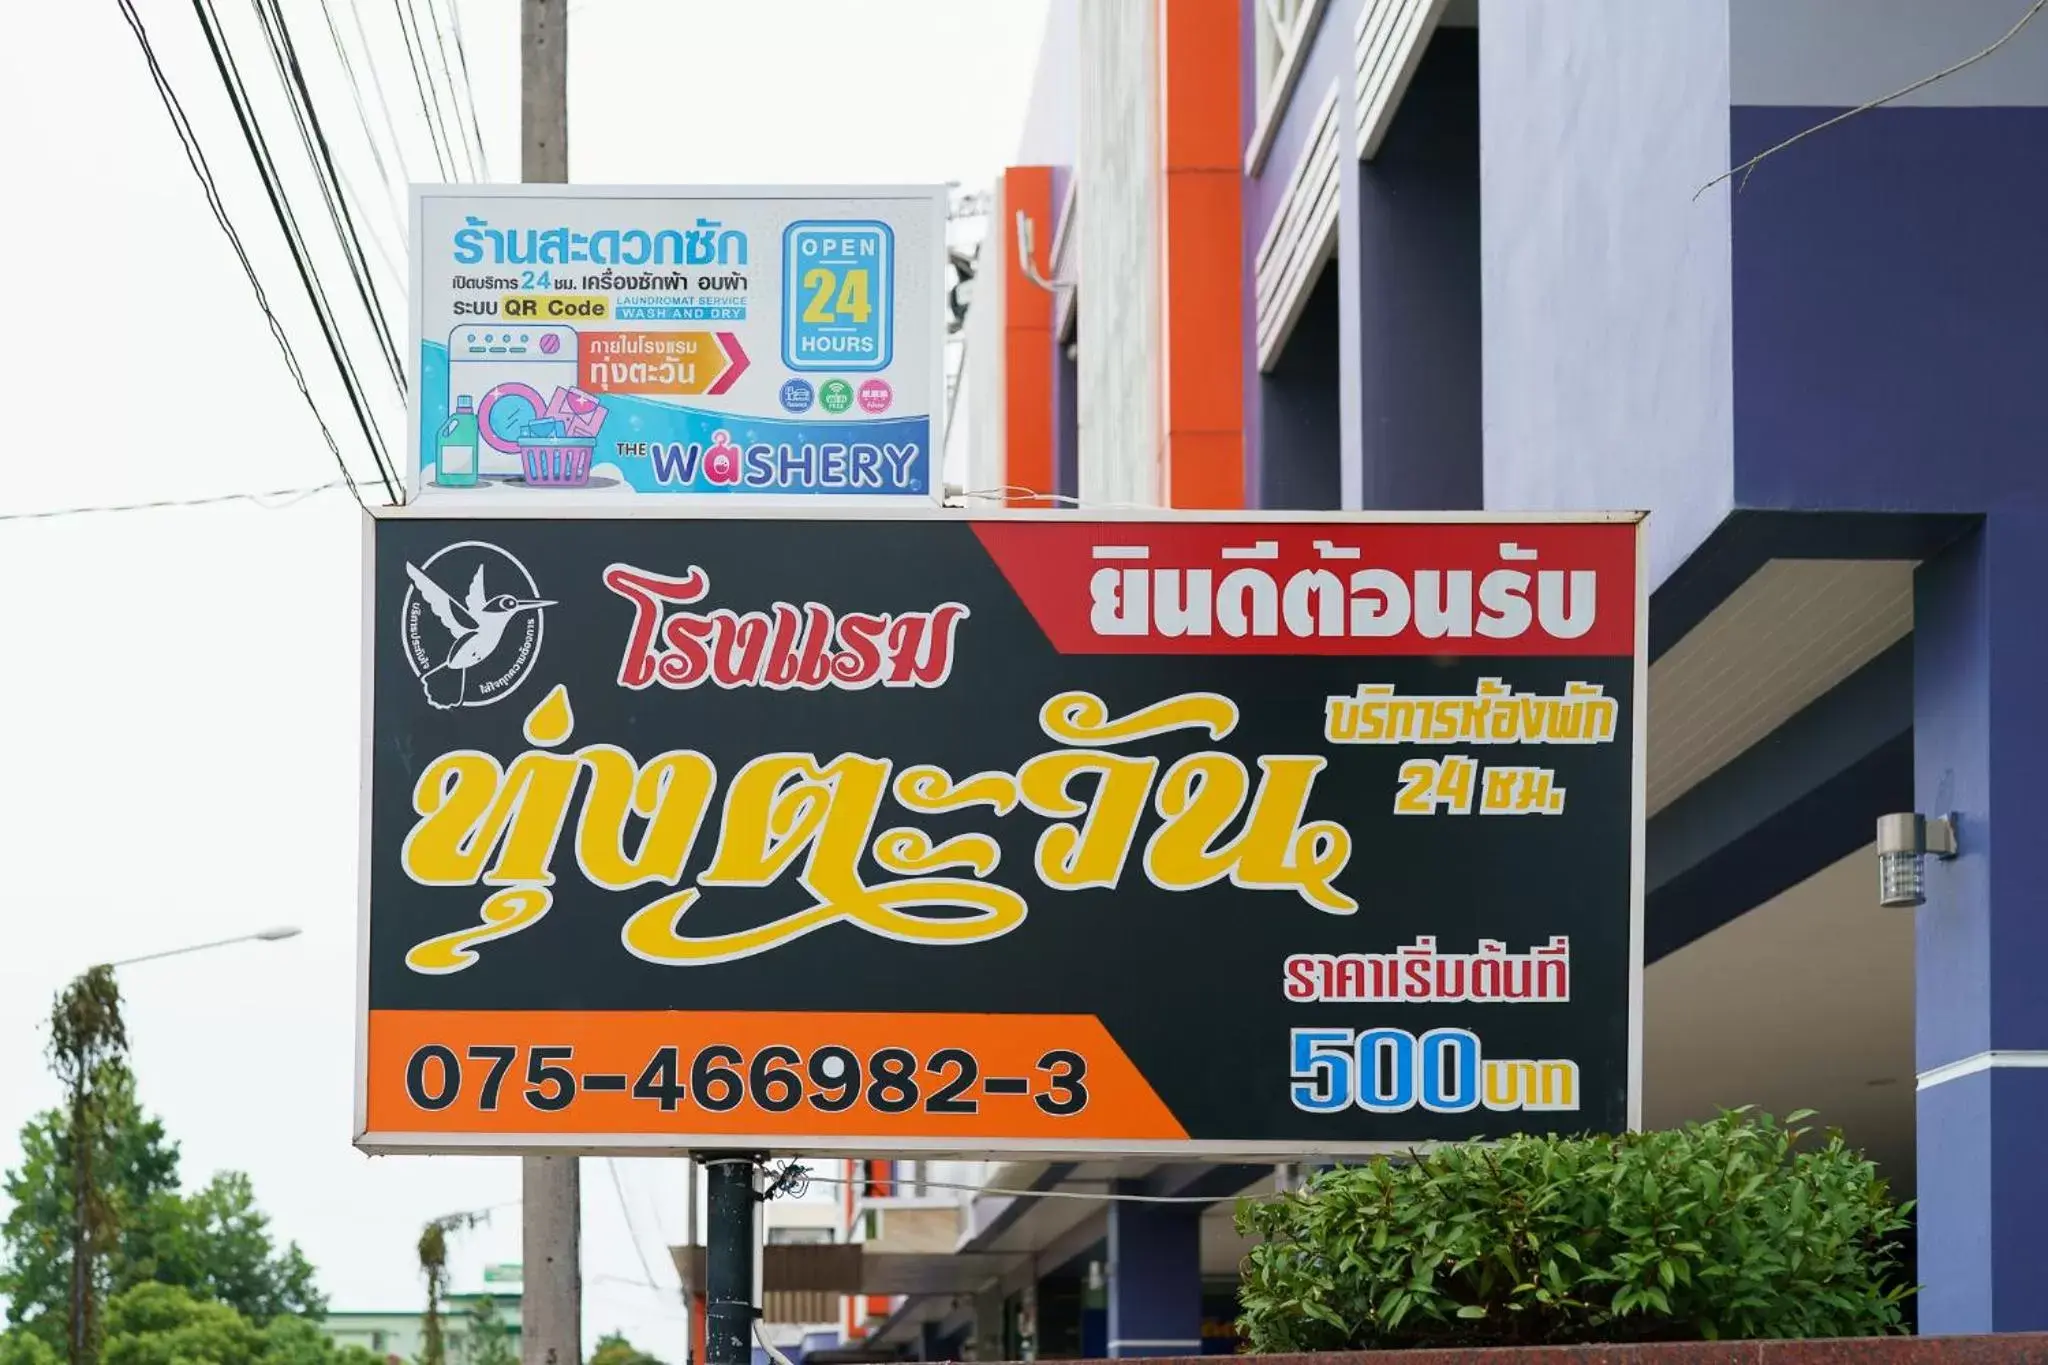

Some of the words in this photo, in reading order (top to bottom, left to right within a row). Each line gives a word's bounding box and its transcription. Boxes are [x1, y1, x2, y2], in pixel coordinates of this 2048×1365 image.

[453, 216, 748, 266] ร้านสะดวกซัก
[801, 238, 875, 257] OPEN
[452, 273, 519, 291] เปิดบริการ
[520, 270, 551, 291] 24
[554, 279, 577, 291] ชม.
[582, 268, 688, 291] เครื่องซักผ้า
[697, 271, 748, 291] อบผ้า
[616, 297, 695, 306] LAUNDROMAT
[698, 297, 747, 306] SERVICE
[802, 268, 872, 323] 24
[452, 301, 498, 316] ระบบ
[504, 299, 538, 317] QR
[548, 299, 605, 316] Code
[623, 308, 667, 319] WASH
[671, 308, 704, 319] AND
[710, 308, 741, 319] DRY
[590, 335, 697, 354] ภายในโรงแรม
[801, 336, 874, 353] HOURS
[590, 356, 696, 391] ทุ่งตะวัน
[617, 443, 646, 457] THE
[1090, 541, 1597, 639] ยินดีต้อนรับ
[603, 562, 971, 691] โรงแรม
[1324, 677, 1617, 744] บริการห้องพัก
[1394, 755, 1477, 815] 24
[1480, 766, 1566, 815] ชม.
[400, 683, 1359, 976] ทุ่งตะวัน
[1284, 935, 1570, 1003] ราคาเริ่มต้นที่
[405, 1044, 1089, 1117] 075-466982-3
[1290, 1027, 1482, 1114] 500
[1482, 1059, 1580, 1112] บาท
